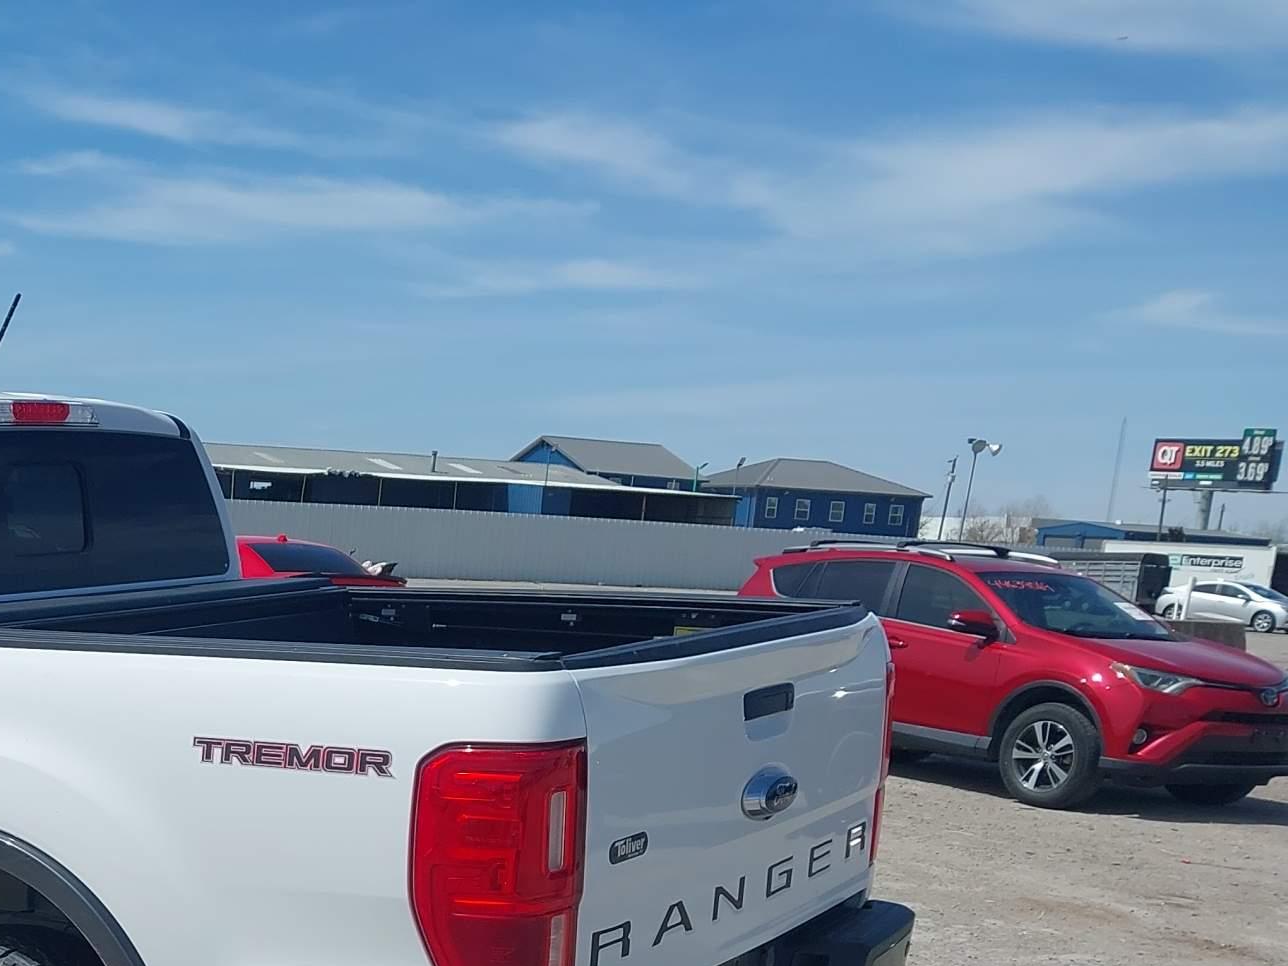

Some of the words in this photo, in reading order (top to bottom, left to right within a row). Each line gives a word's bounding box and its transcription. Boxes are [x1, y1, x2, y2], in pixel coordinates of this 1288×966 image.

[1158, 446, 1180, 465] QT
[1185, 445, 1214, 457] EXIT
[1214, 445, 1240, 457] 273
[1182, 555, 1242, 568] Enterprise
[192, 736, 394, 778] TREMOR
[614, 837, 646, 857] Toliver
